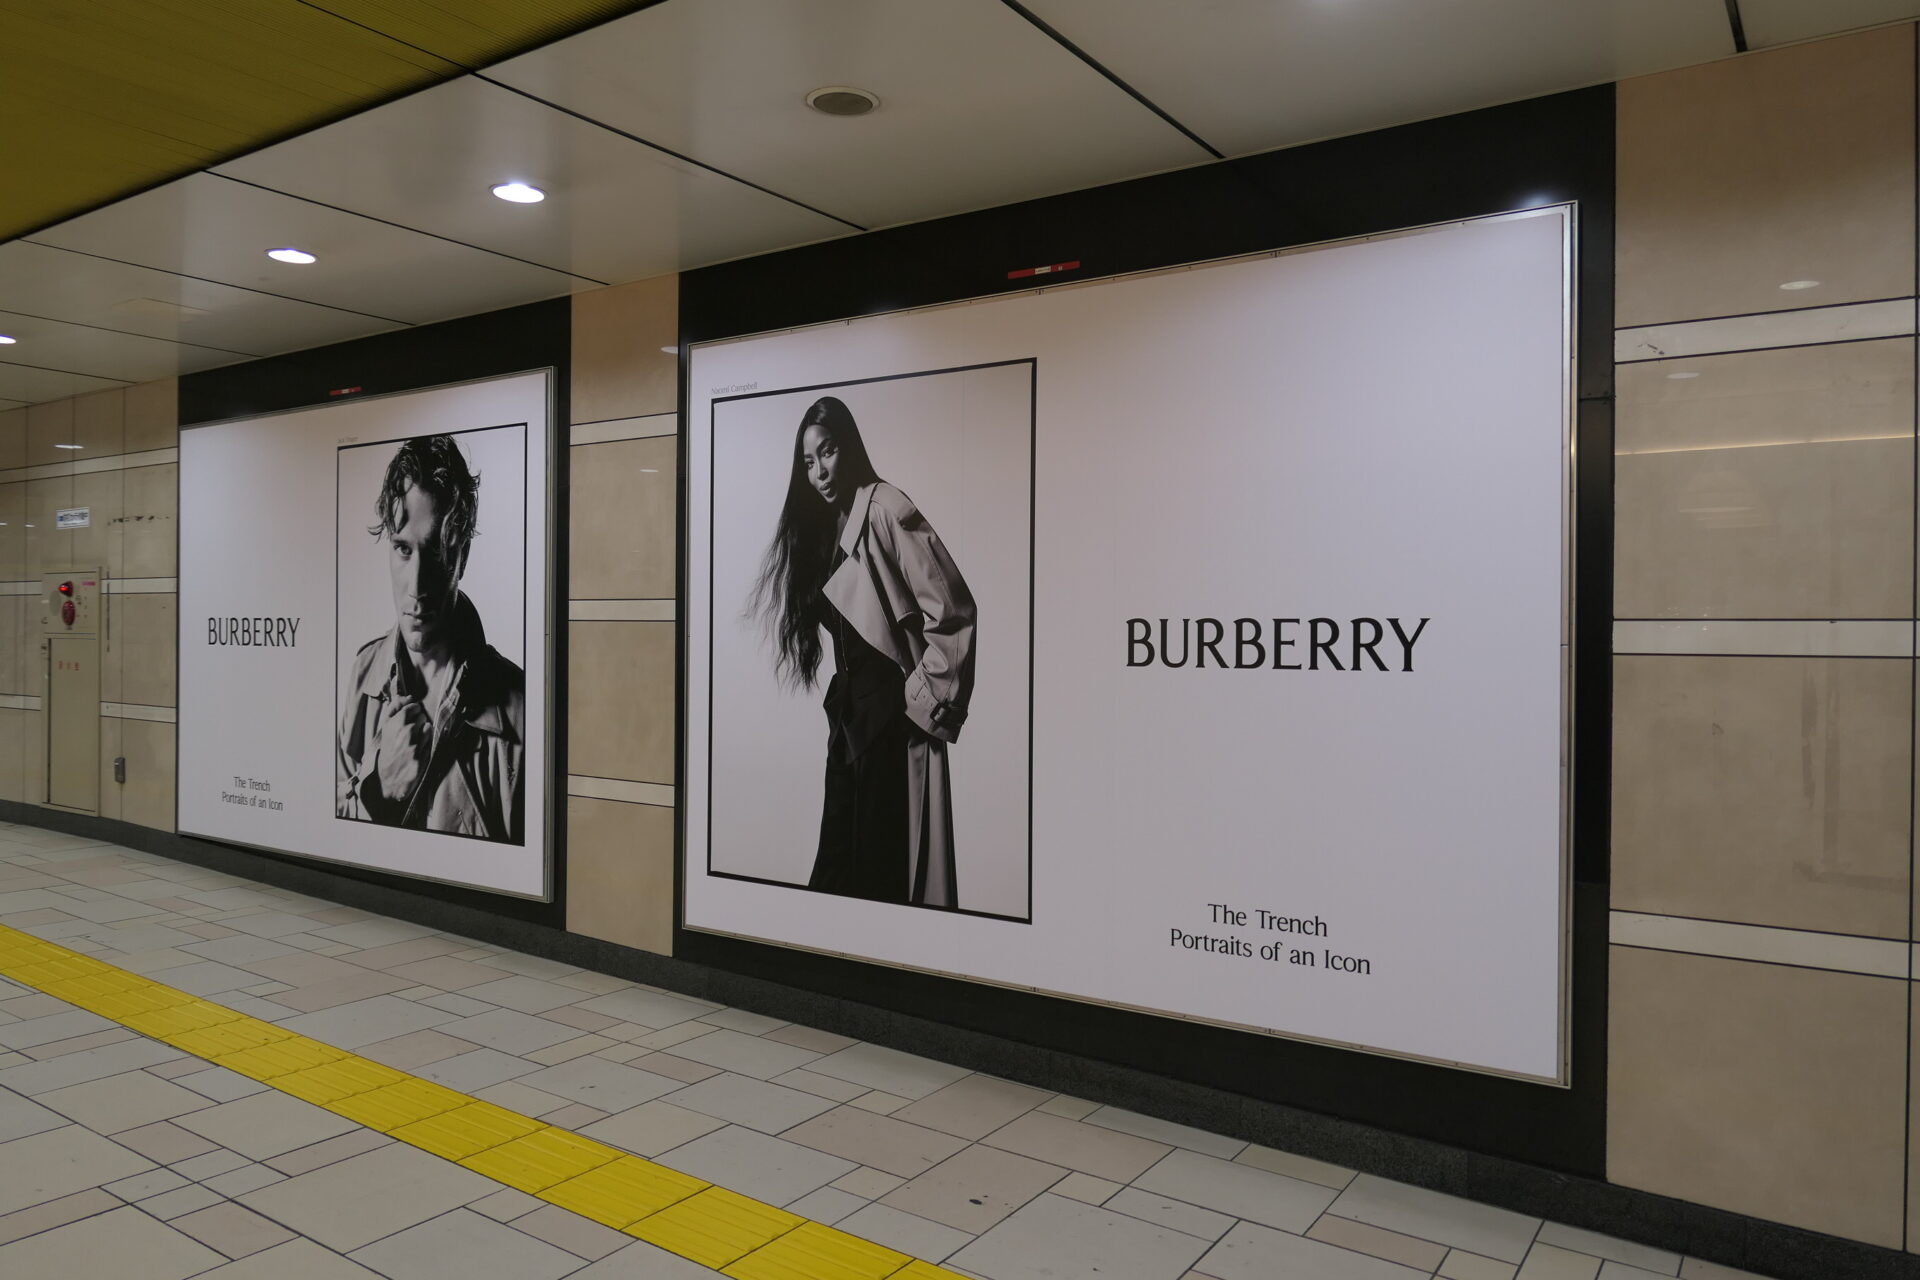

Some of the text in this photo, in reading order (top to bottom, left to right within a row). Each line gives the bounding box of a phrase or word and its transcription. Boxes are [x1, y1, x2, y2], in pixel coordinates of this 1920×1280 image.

[731, 381, 758, 393] Campbell
[207, 617, 300, 648] BURBERRY
[1126, 617, 1430, 672] BURBERRY
[233, 776, 271, 792] The Trench
[222, 791, 283, 811] Portraits of an Icon
[1207, 903, 1328, 937] The Trench
[1170, 928, 1371, 975] Portraits of an Icon
